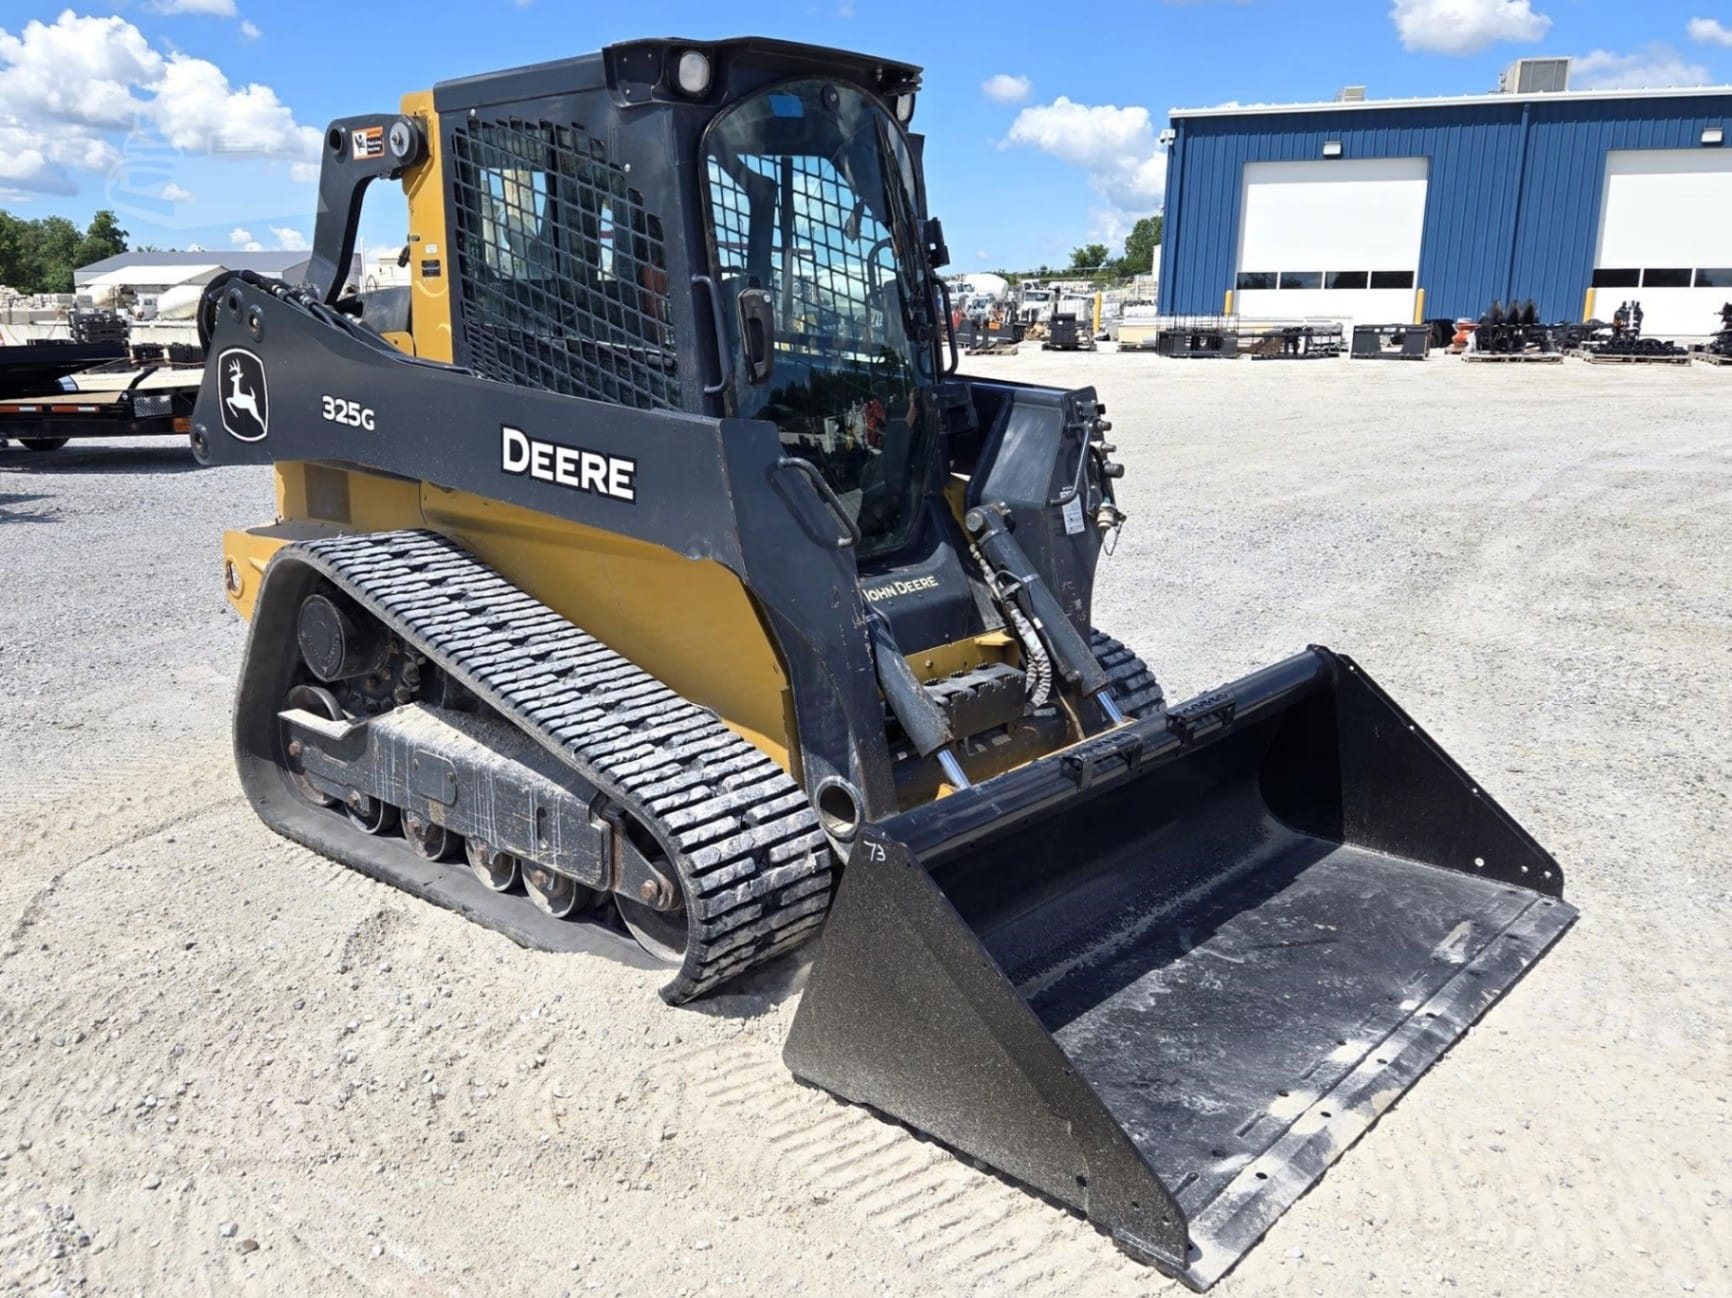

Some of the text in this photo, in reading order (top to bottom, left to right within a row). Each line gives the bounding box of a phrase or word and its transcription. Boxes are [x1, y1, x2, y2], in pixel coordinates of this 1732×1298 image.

[322, 395, 375, 431] 325G
[502, 426, 635, 501] DEERE
[894, 575, 939, 595] DEERE
[863, 840, 886, 862] 73
